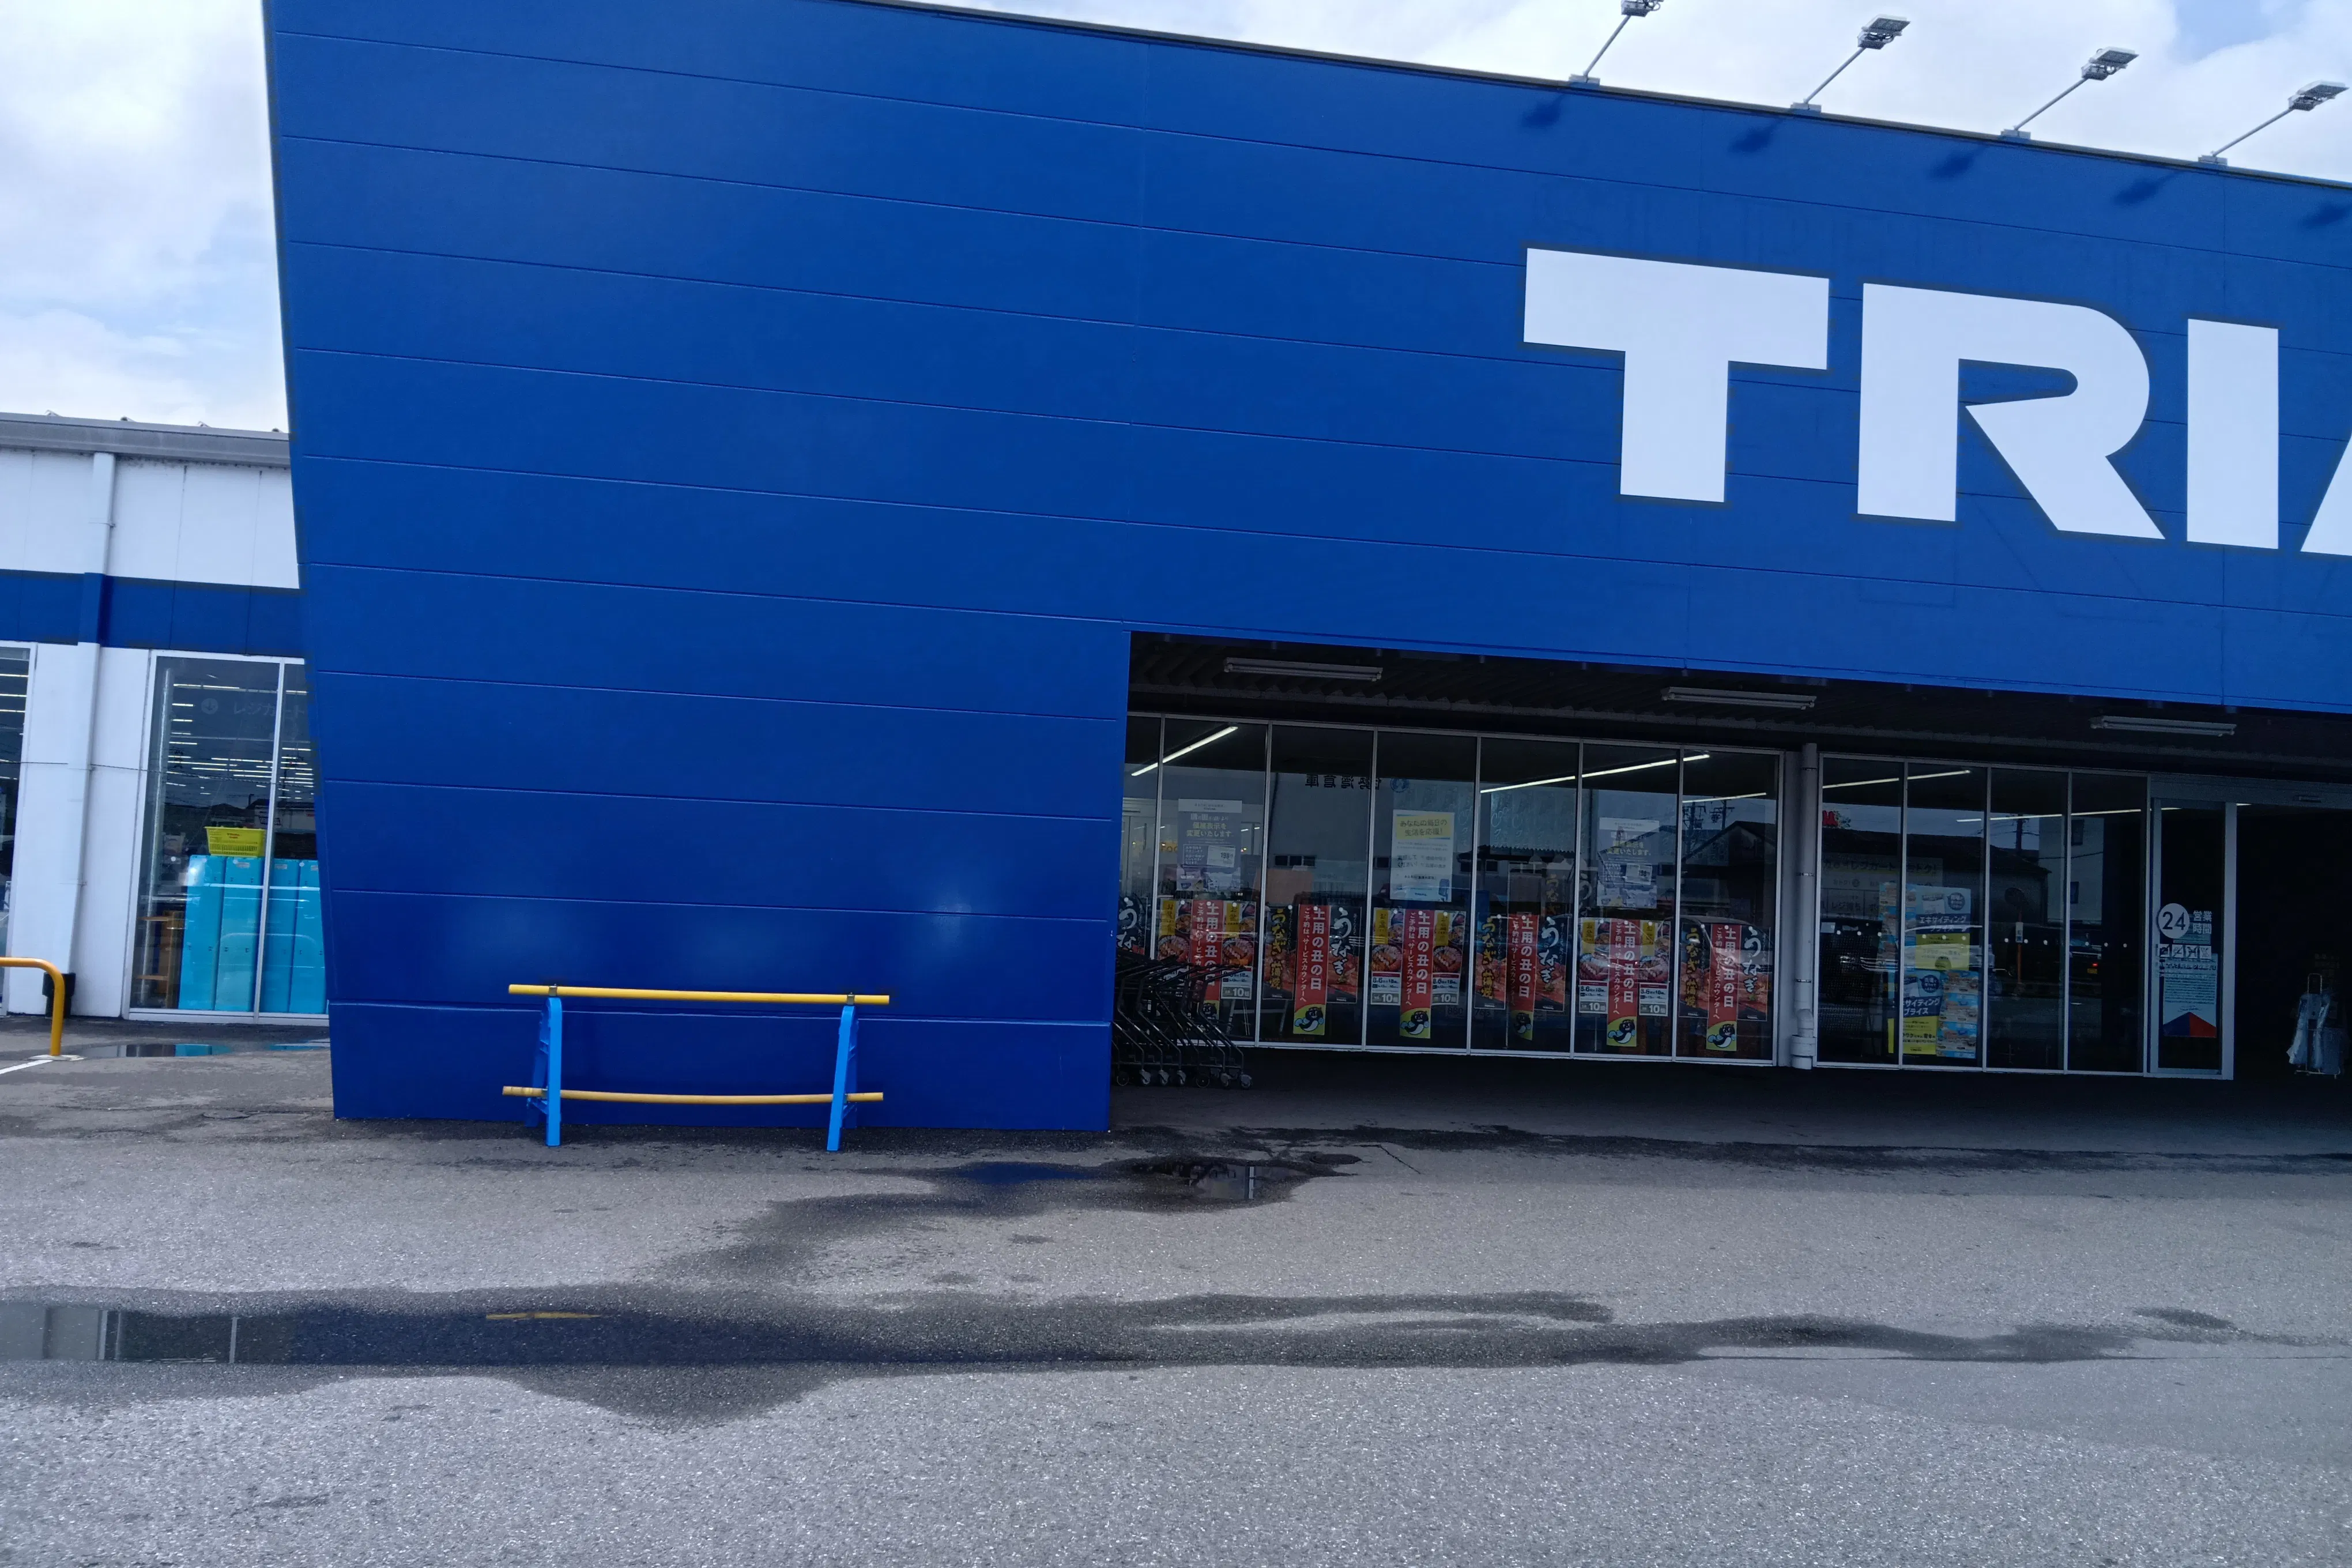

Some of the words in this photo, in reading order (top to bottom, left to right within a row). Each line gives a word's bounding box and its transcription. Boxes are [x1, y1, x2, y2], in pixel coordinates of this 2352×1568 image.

[1311, 908, 1325, 990] 土用の丑の日
[1330, 907, 1352, 975] うなぎ
[1416, 912, 1431, 994] 土用の丑の日
[1538, 916, 1559, 983] うなぎ
[1918, 915, 1967, 924] エキサイティング
[2162, 911, 2185, 930] 24
[2192, 924, 2212, 934] 時間
[2193, 910, 2212, 922] 営業
[1299, 908, 1310, 1002] ご予約は、サービスカウンターへ
[1405, 911, 1416, 1006] ご予約は、サービスカウンターへ
[1518, 917, 1533, 998] 土用の丑の日
[1613, 920, 1623, 1015] ご予約は、サービスカウンターへ
[1623, 922, 1636, 1003] 土用の丑の日
[1723, 927, 1737, 1008] 土用の丑の日
[1740, 926, 1761, 993] うなぎ
[1904, 997, 1940, 1007] サイティング
